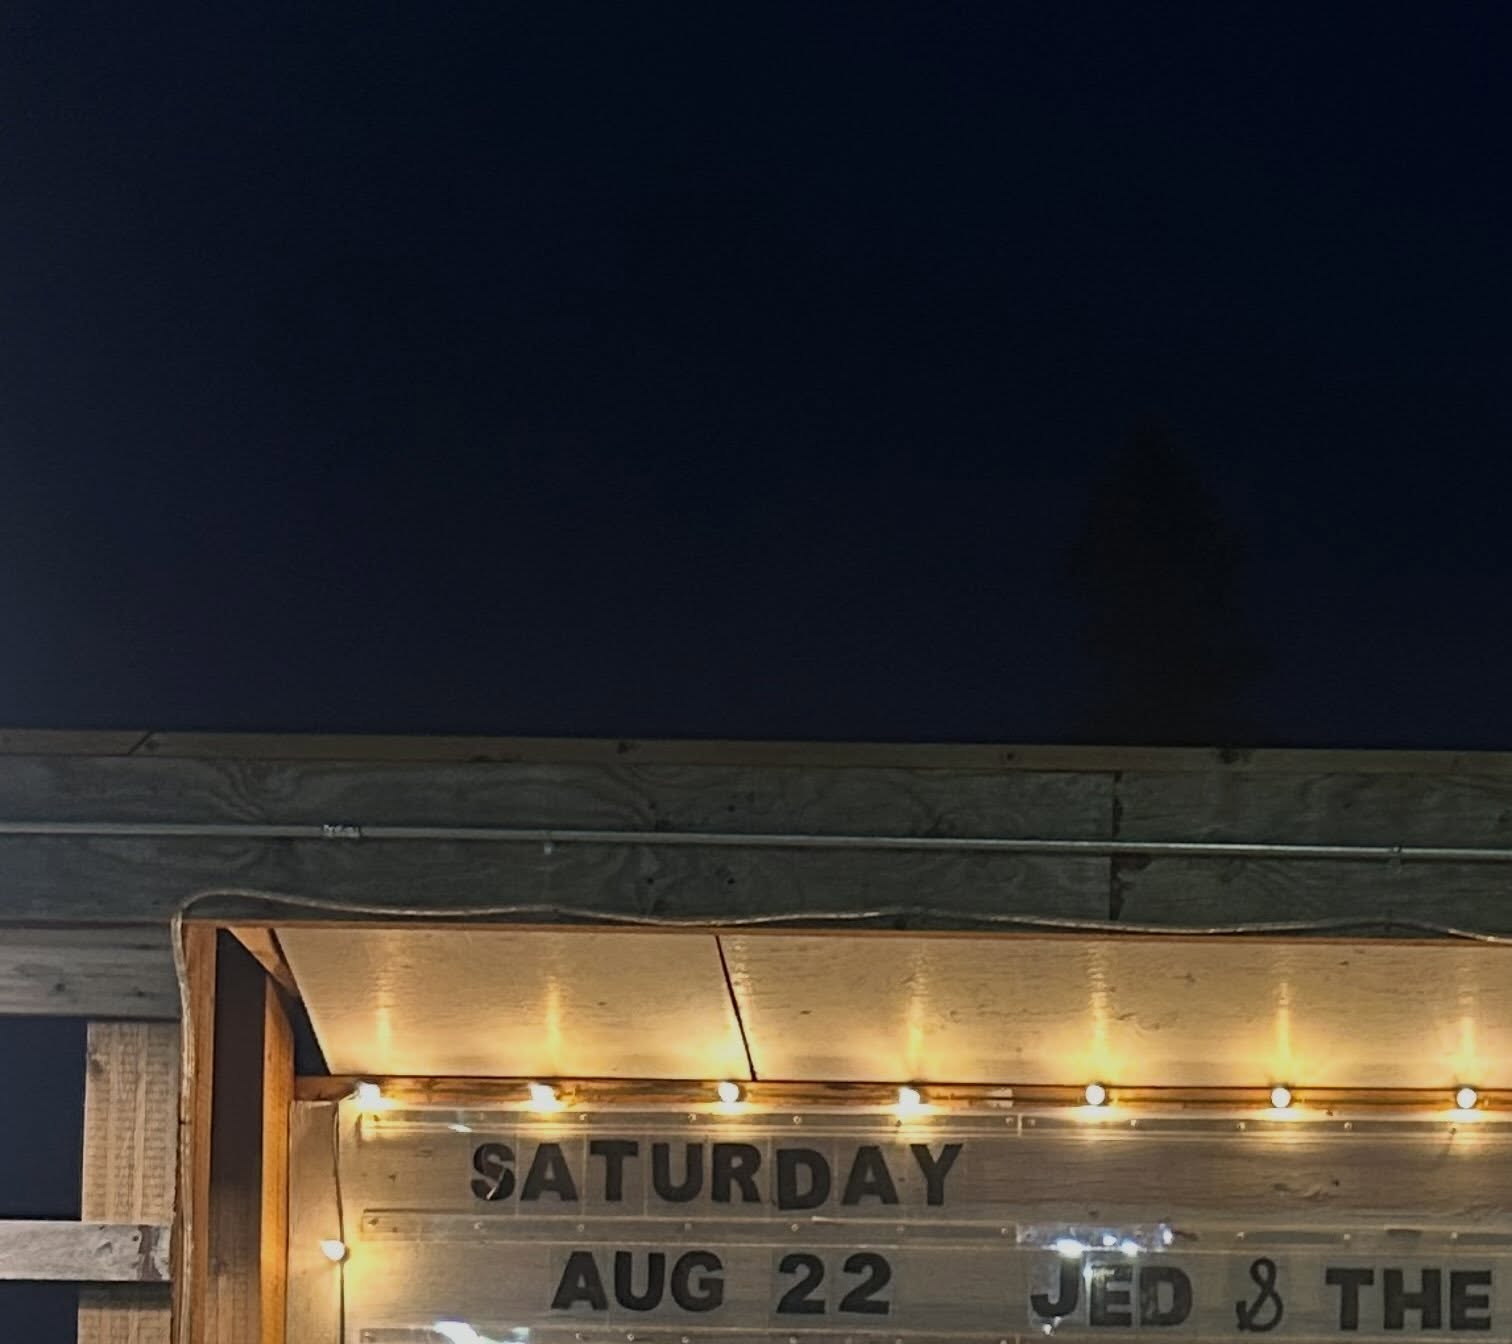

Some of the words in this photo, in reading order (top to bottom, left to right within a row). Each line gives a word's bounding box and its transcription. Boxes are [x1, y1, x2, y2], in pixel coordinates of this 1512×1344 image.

[470, 1140, 964, 1211] SATURDAY
[551, 1249, 725, 1314] AUG
[777, 1253, 893, 1316] 22
[1031, 1262, 1193, 1329] JED
[1235, 1257, 1284, 1333] &
[1325, 1267, 1493, 1333] THE
